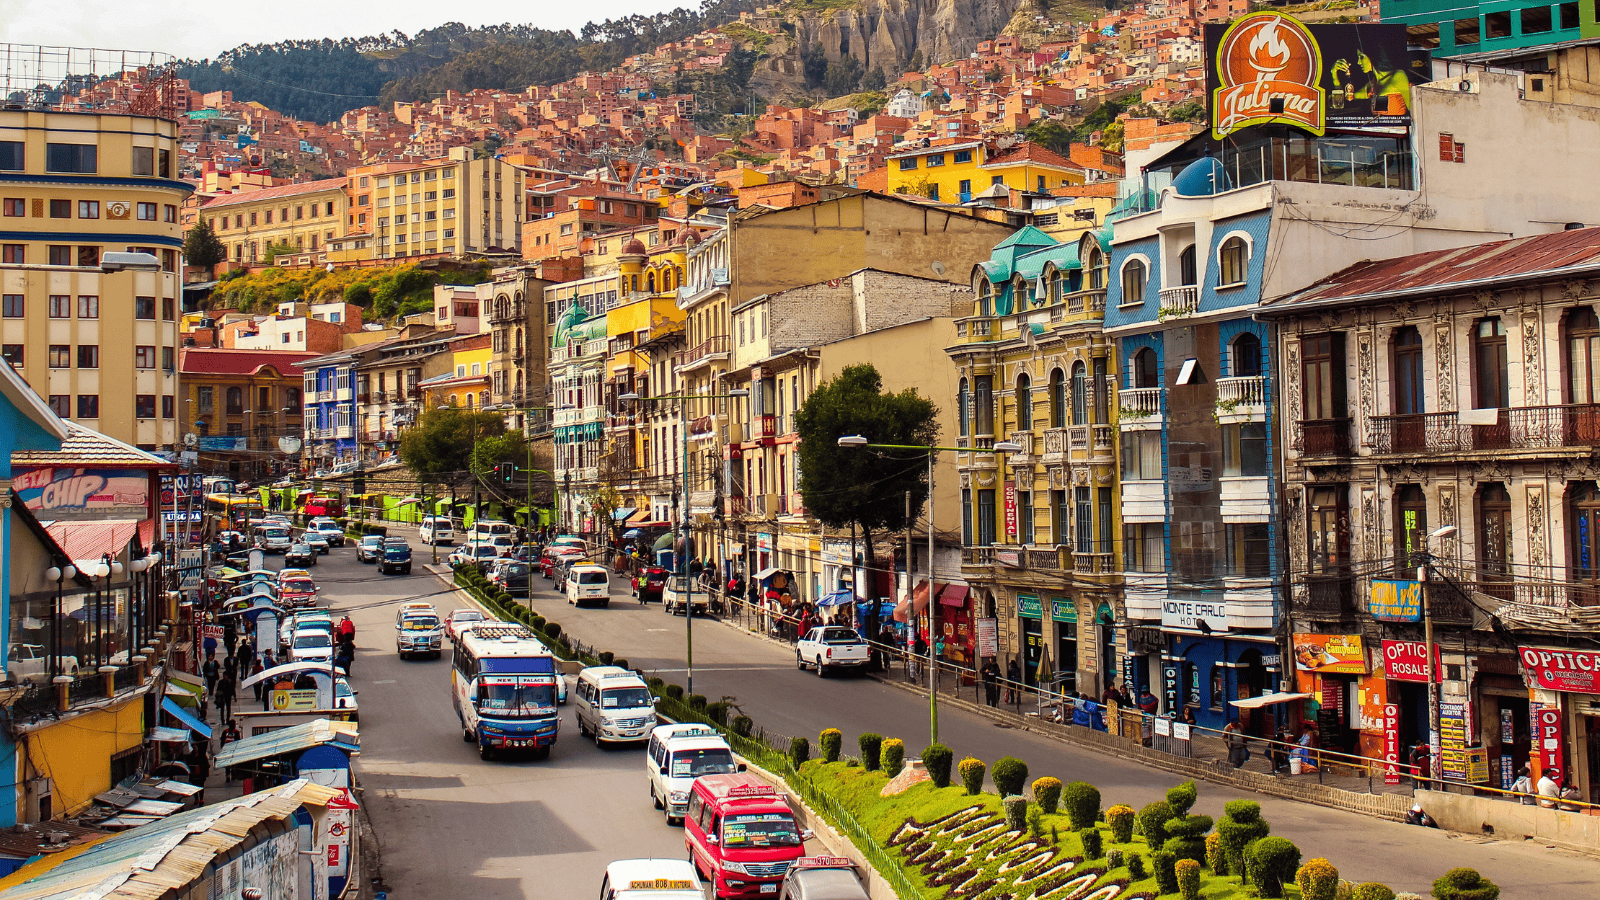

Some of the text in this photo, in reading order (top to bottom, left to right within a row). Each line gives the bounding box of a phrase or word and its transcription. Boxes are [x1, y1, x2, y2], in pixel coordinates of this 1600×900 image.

[1006, 486, 1015, 534] CONTINENTAL
[1163, 602, 1226, 617] MONTE CARLO
[1387, 643, 1428, 660] OPTIC
[1124, 656, 1134, 685] OPTICA
[1392, 663, 1429, 676] ROSALE
[1385, 706, 1397, 775] OPTICA
[817, 856, 829, 864] 370
